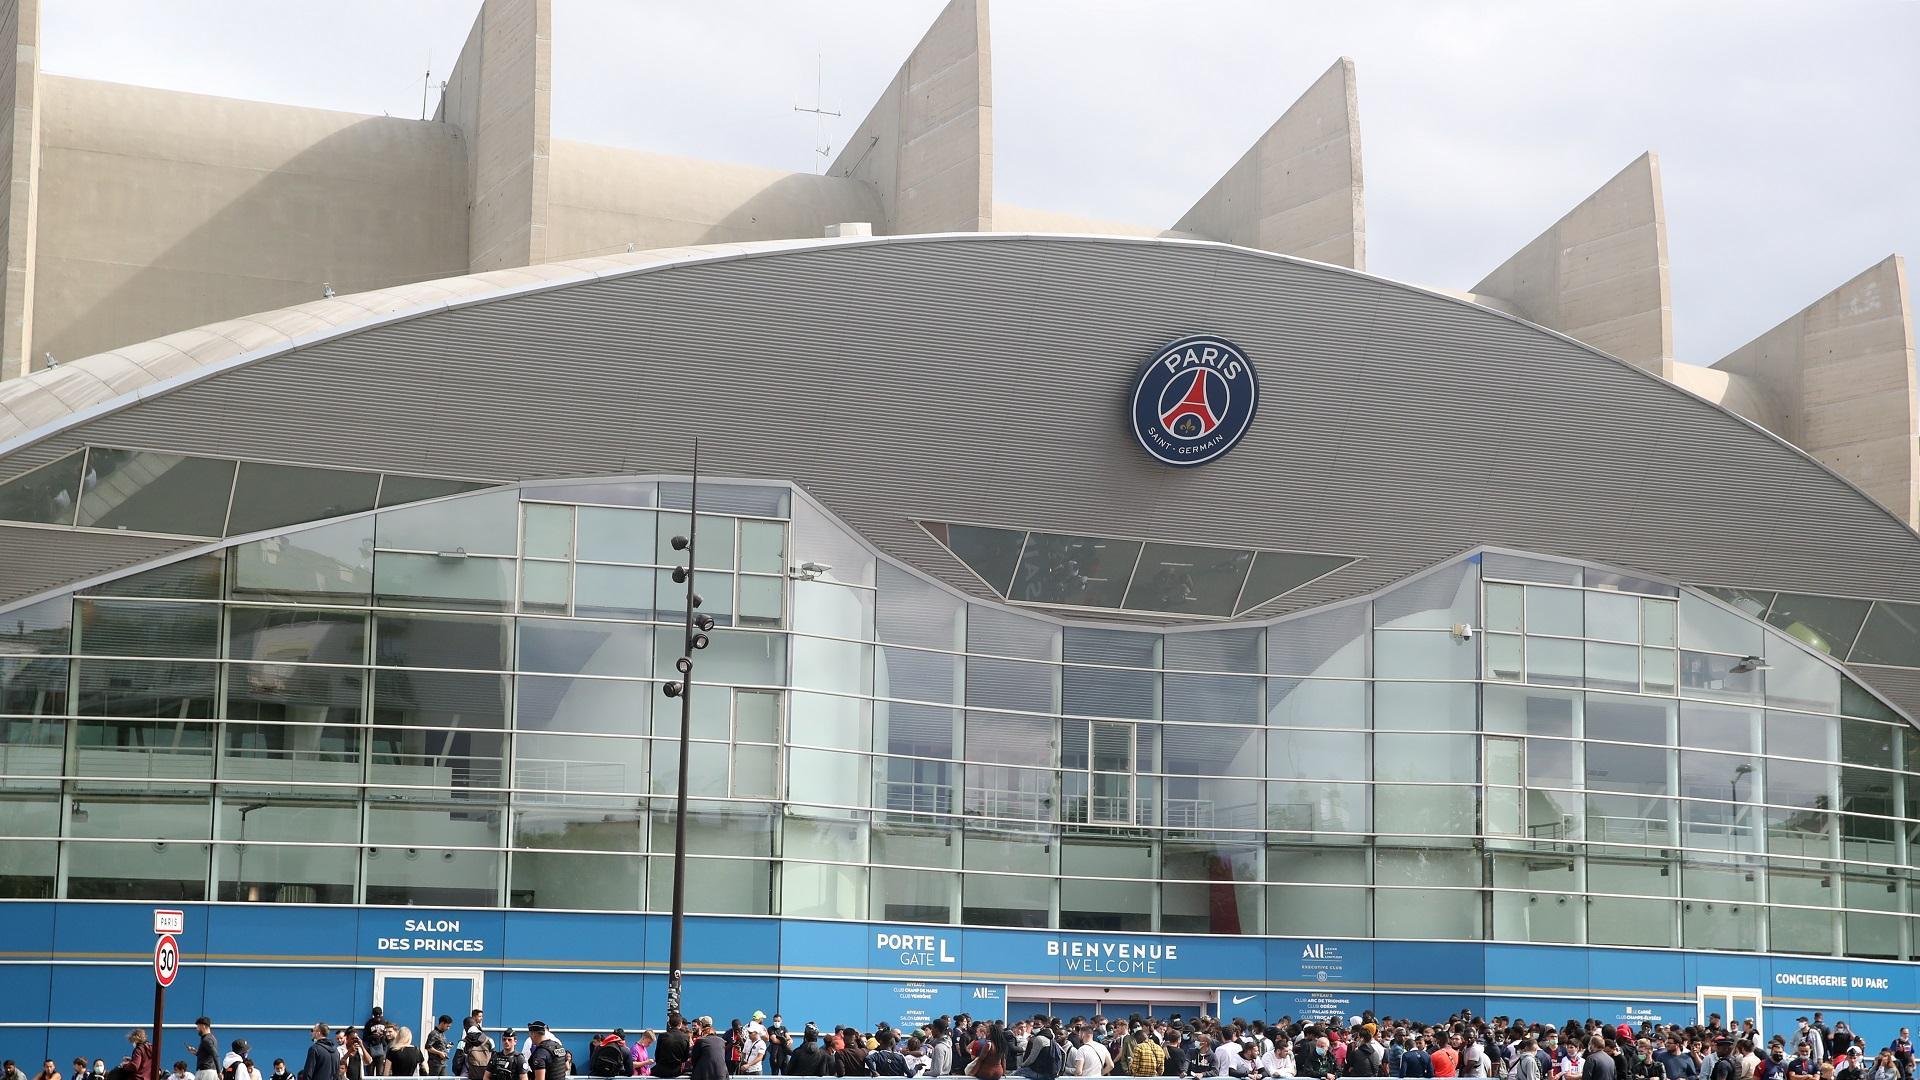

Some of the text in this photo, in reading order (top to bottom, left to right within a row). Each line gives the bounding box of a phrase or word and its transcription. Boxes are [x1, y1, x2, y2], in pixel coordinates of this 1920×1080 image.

[1164, 347, 1242, 380] PARIS
[1148, 426, 1224, 454] SAINT GERMAIN
[160, 917, 178, 927] PARIS
[404, 919, 460, 933] SALON
[377, 937, 484, 952] DES PRINCES
[877, 933, 935, 951] PORTE
[1047, 940, 1177, 960] BIENVENUE
[900, 951, 935, 966] GATE
[940, 939, 955, 963] L
[160, 948, 174, 972] 30
[1065, 958, 1157, 974] WELCOME
[1775, 973, 1889, 989] CONCIERGERIE DU PARC
